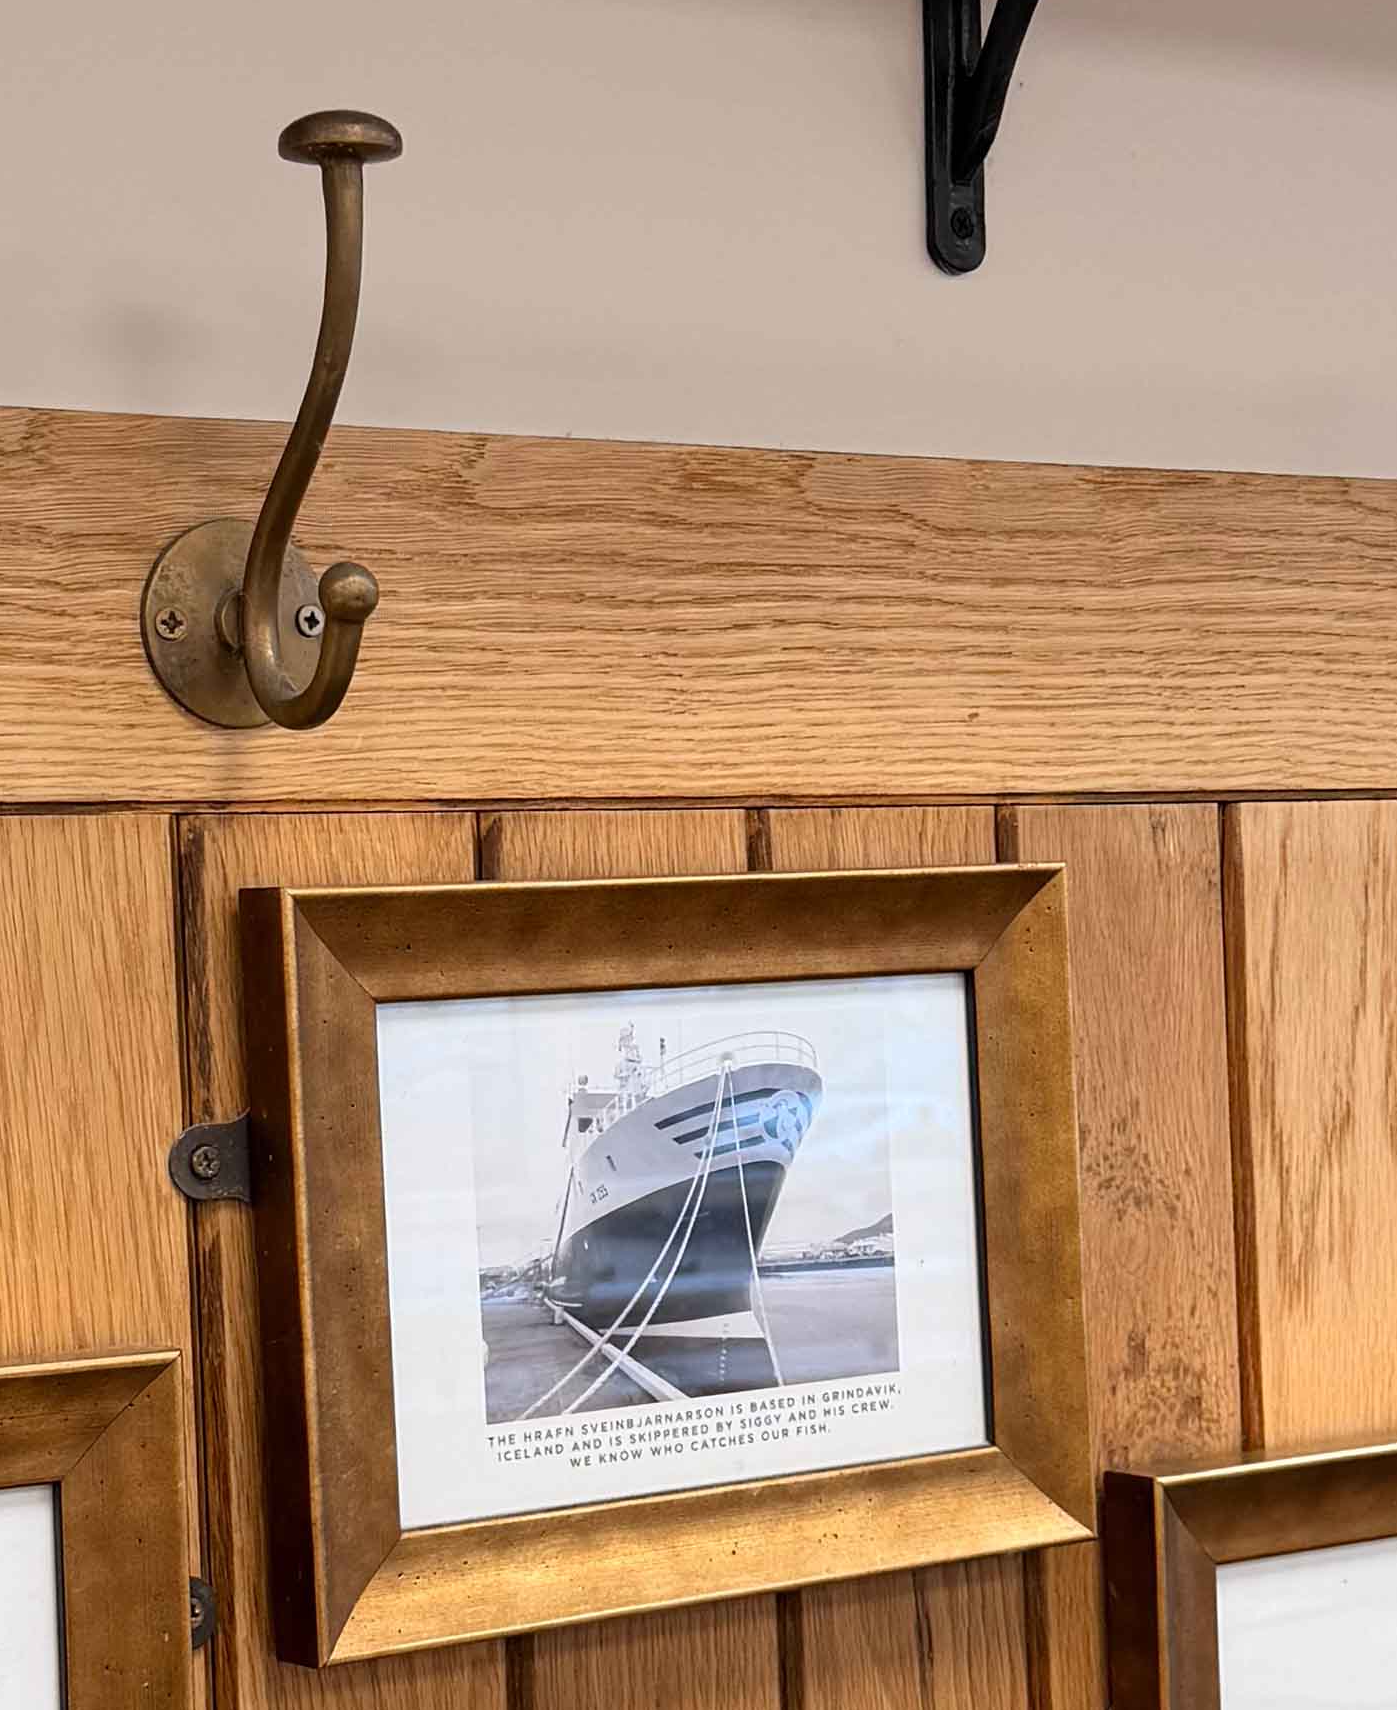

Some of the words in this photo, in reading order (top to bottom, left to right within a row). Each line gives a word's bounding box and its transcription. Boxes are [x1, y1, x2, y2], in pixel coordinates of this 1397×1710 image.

[488, 1434, 516, 1448] THE
[523, 1426, 574, 1442] HRAFN
[581, 1406, 724, 1435] SVEINBJARNARSON
[731, 1403, 743, 1415] IS
[750, 1397, 795, 1413] BASED
[802, 1394, 815, 1406] IN
[498, 1444, 564, 1462] ICELAND
[572, 1438, 602, 1451] AND
[609, 1435, 622, 1447] IS
[629, 1424, 709, 1444] SKIPPERED
[716, 1420, 733, 1432] BY
[740, 1414, 782, 1429] SIGGY
[789, 1409, 816, 1423] AND
[823, 1406, 845, 1418] HIS
[570, 1455, 591, 1468] WE
[598, 1449, 643, 1465] KNOW
[650, 1442, 684, 1457] WHO
[690, 1433, 755, 1451] CATCHES
[761, 1427, 789, 1441] OUR
